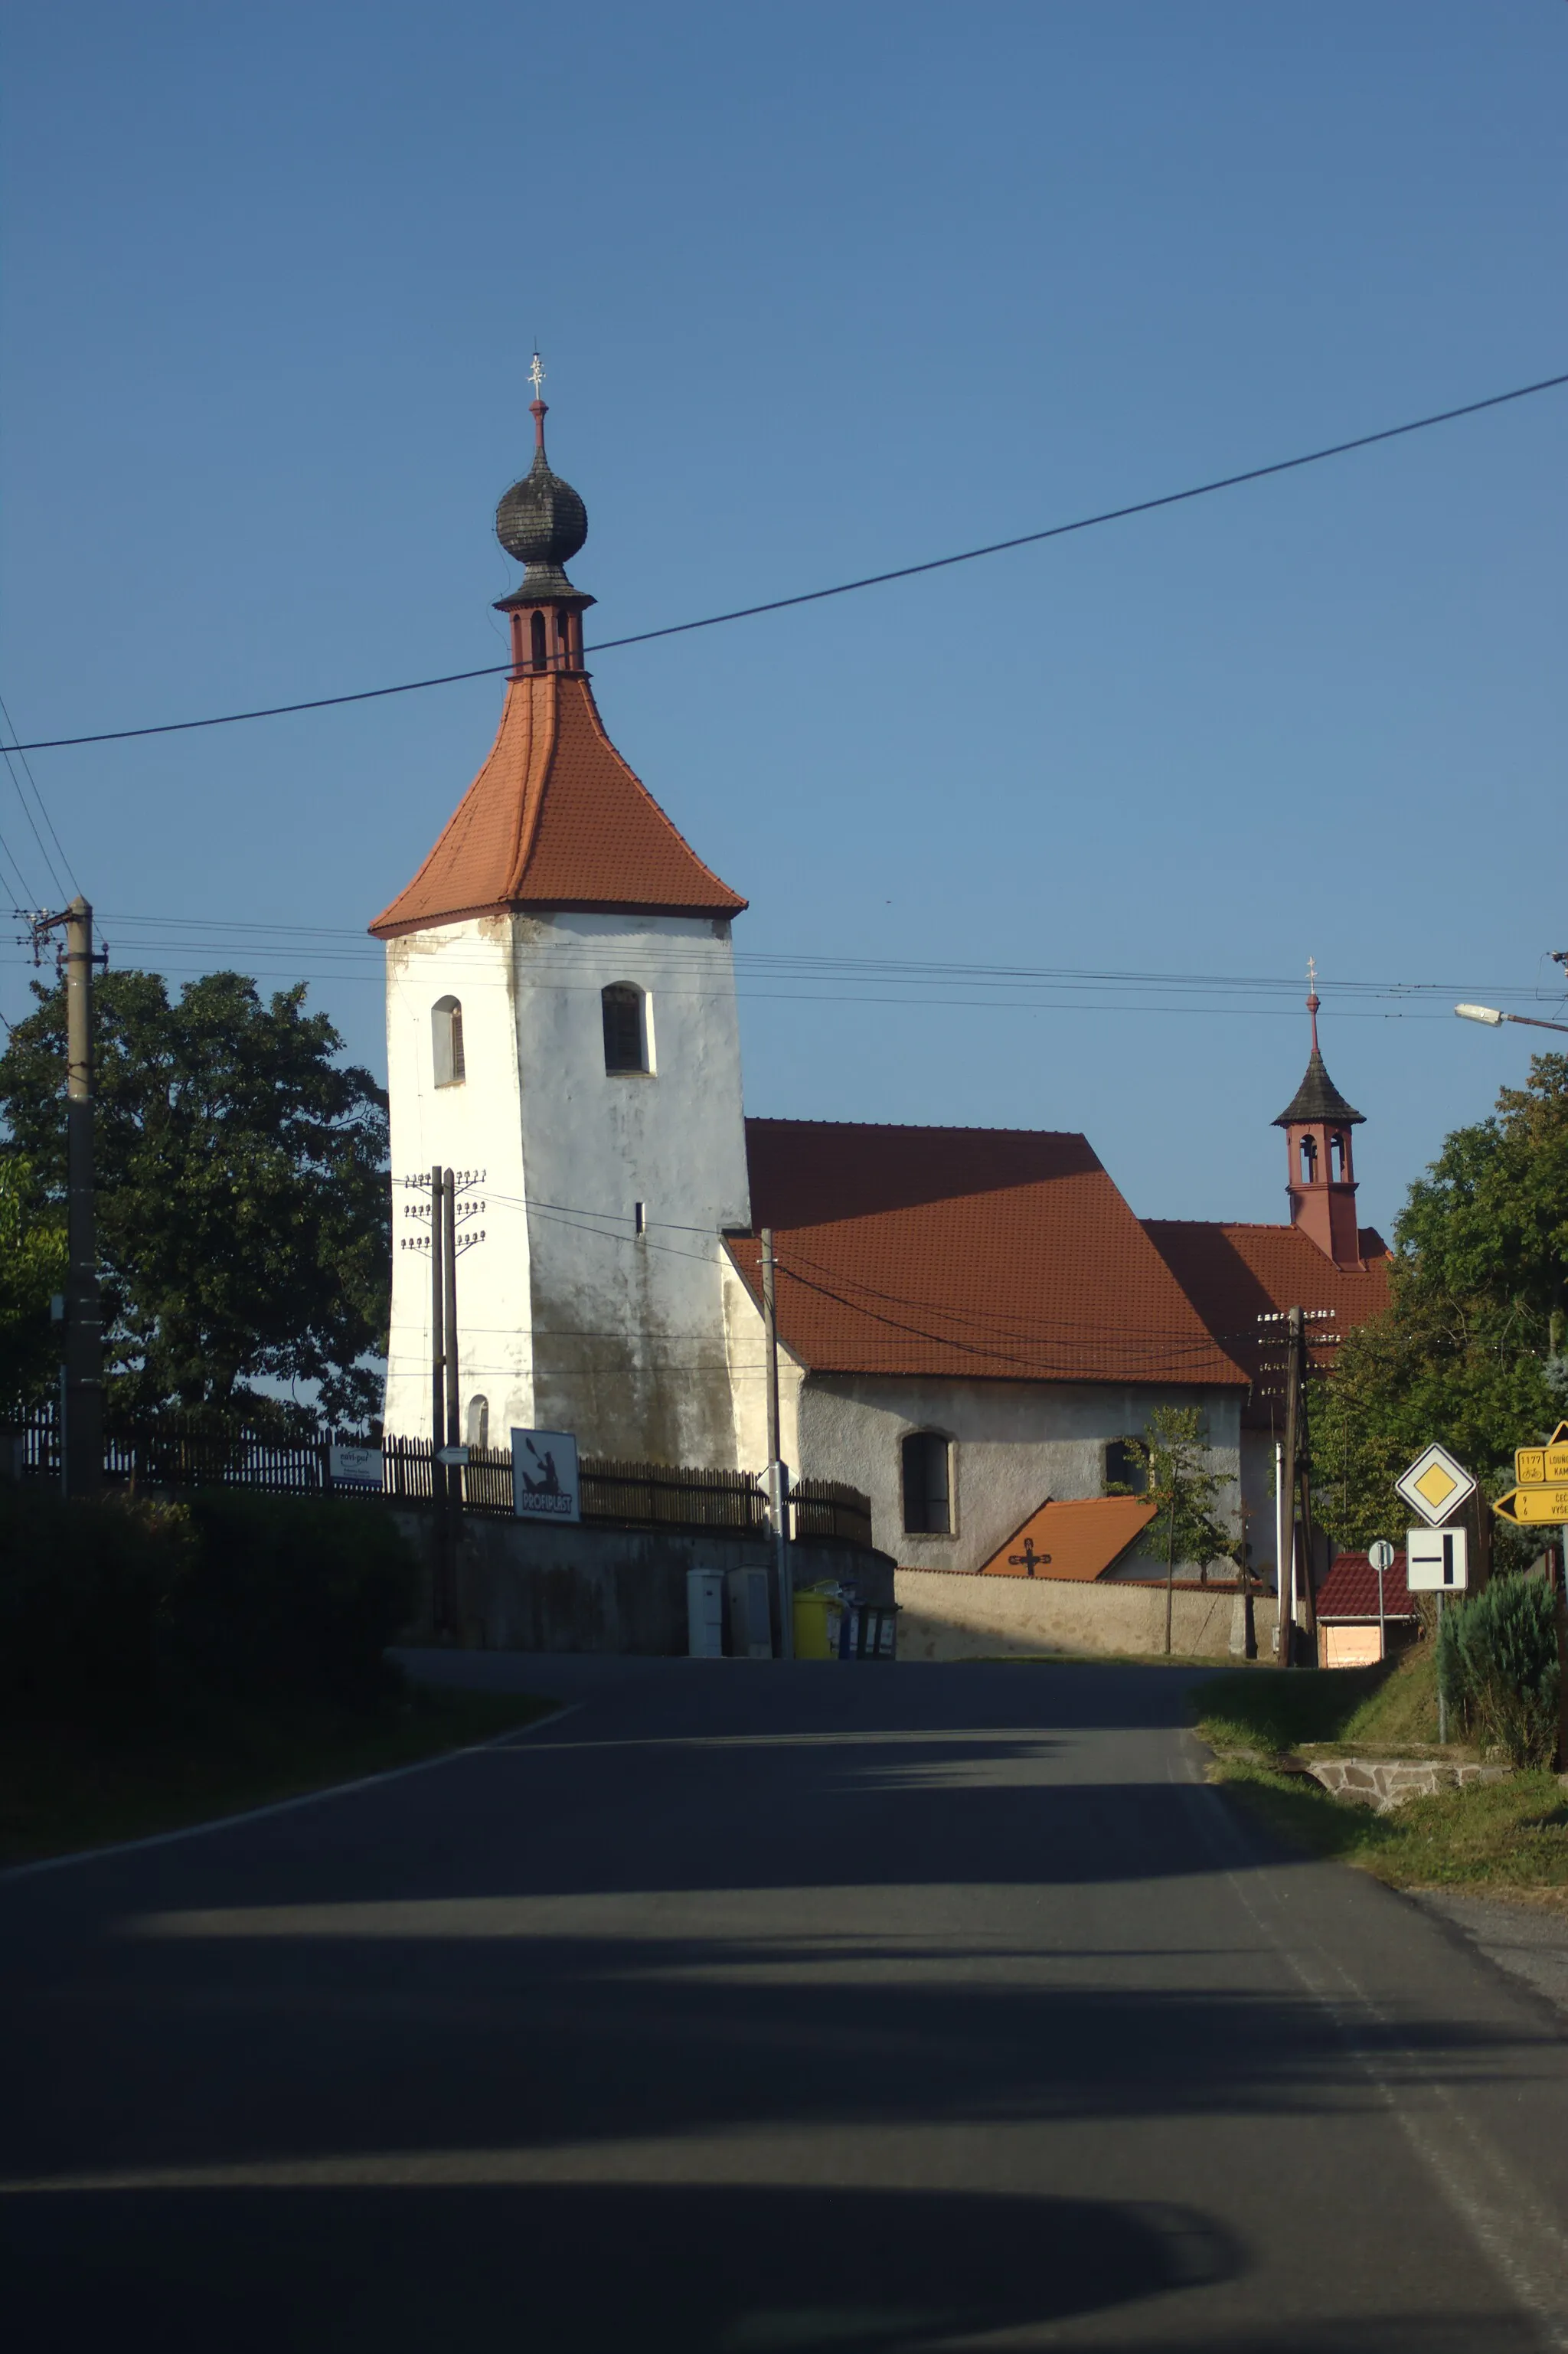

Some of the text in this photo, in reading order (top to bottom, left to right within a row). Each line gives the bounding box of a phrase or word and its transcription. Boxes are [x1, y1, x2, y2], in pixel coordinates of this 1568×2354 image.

[1521, 1456, 1540, 1464] 1177
[522, 1491, 572, 1513] PROFIPLAST
[1523, 1496, 1527, 1504] 9
[1524, 1507, 1528, 1515] 6
